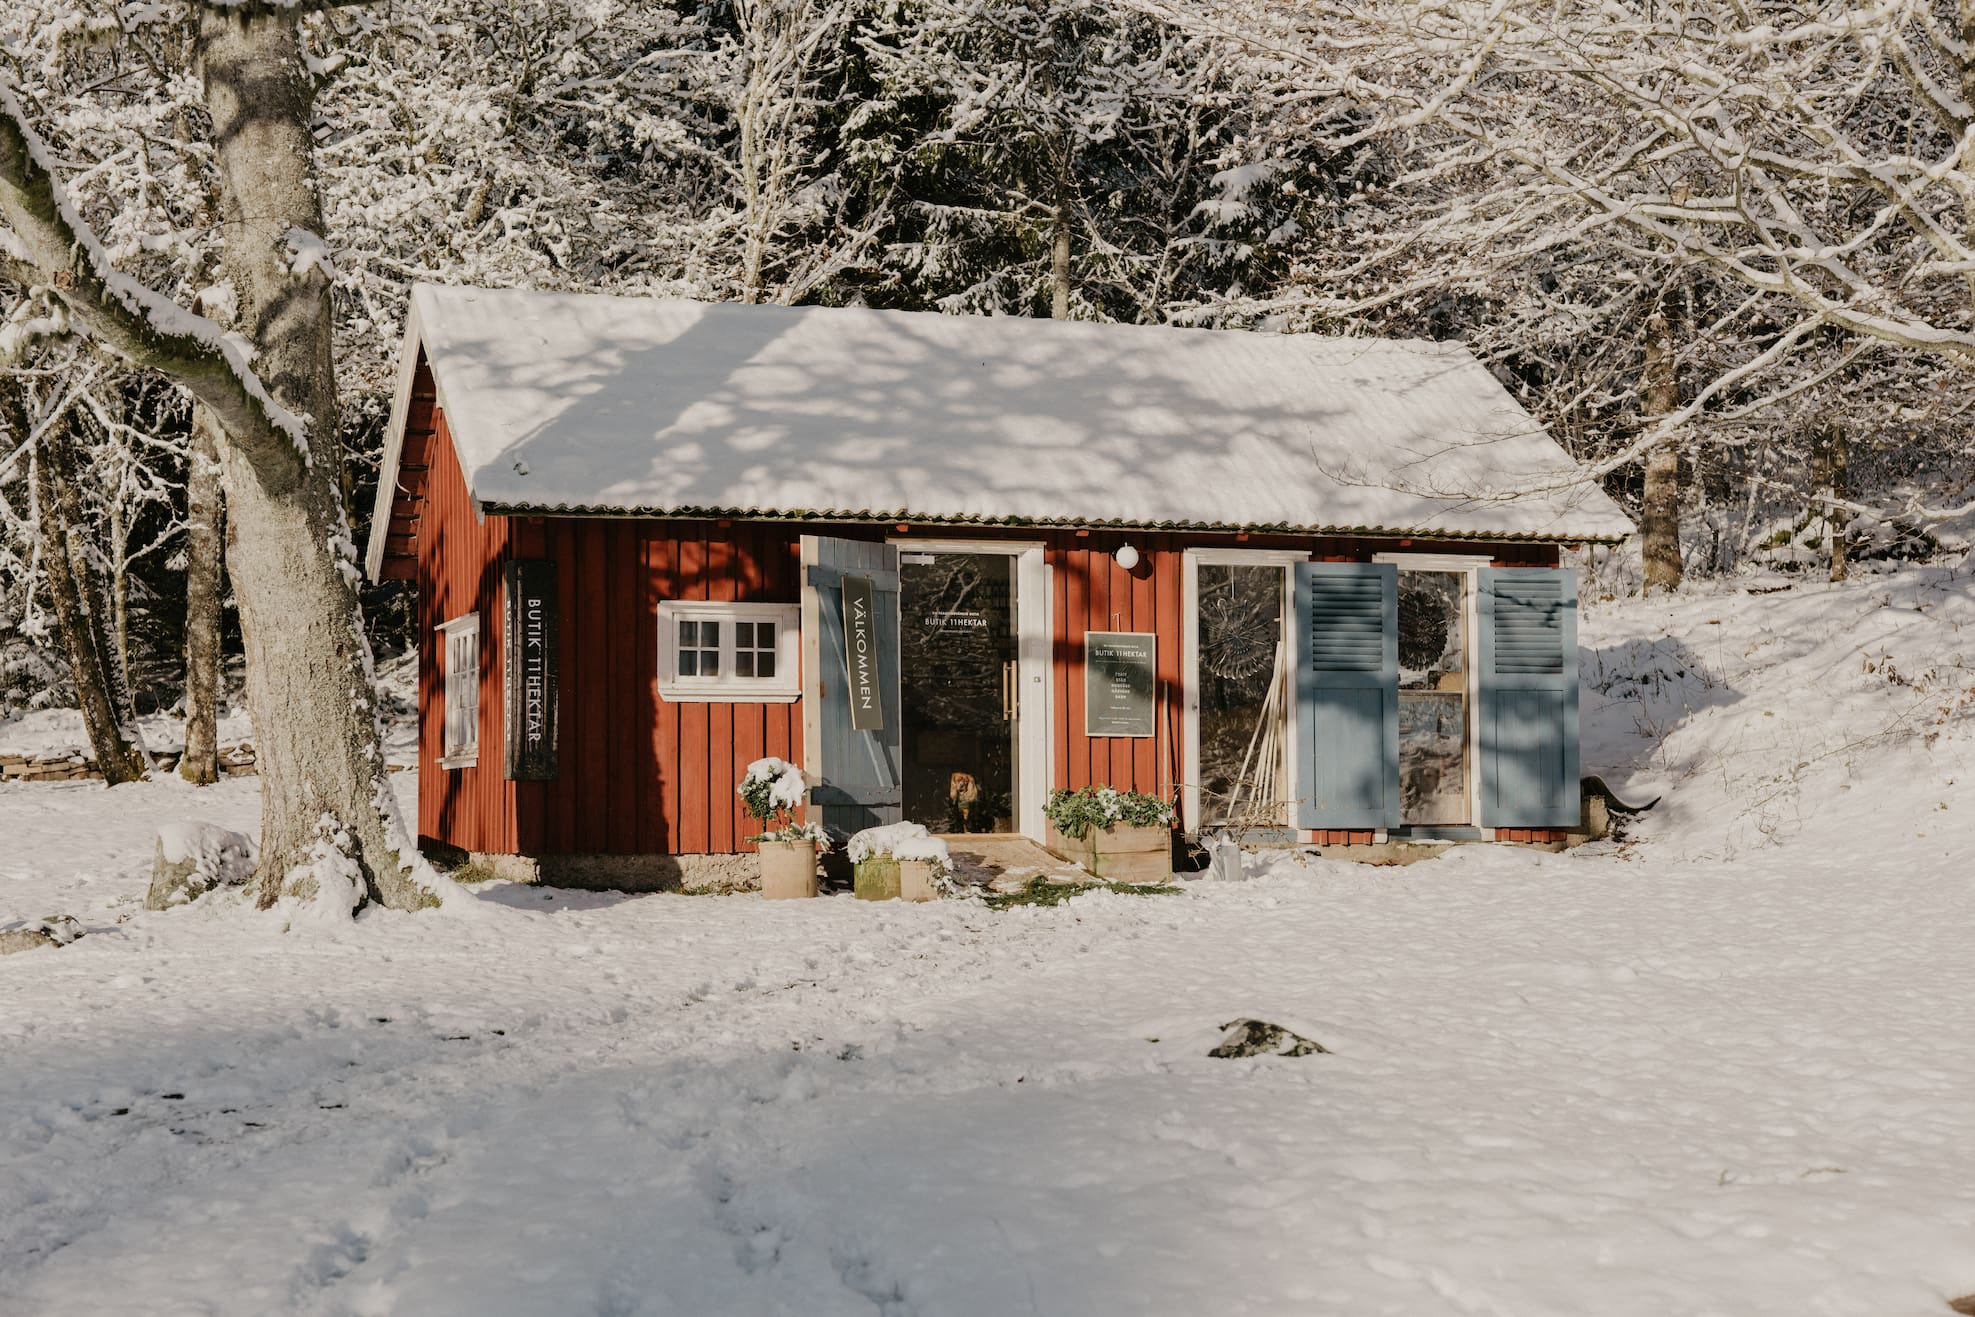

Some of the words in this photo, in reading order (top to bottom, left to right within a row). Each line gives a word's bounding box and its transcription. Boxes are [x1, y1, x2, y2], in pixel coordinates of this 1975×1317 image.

[528, 599, 541, 647] BUTIK
[853, 597, 873, 709] VÄLKOMMEN
[528, 658, 541, 742] 11HEKTAR
